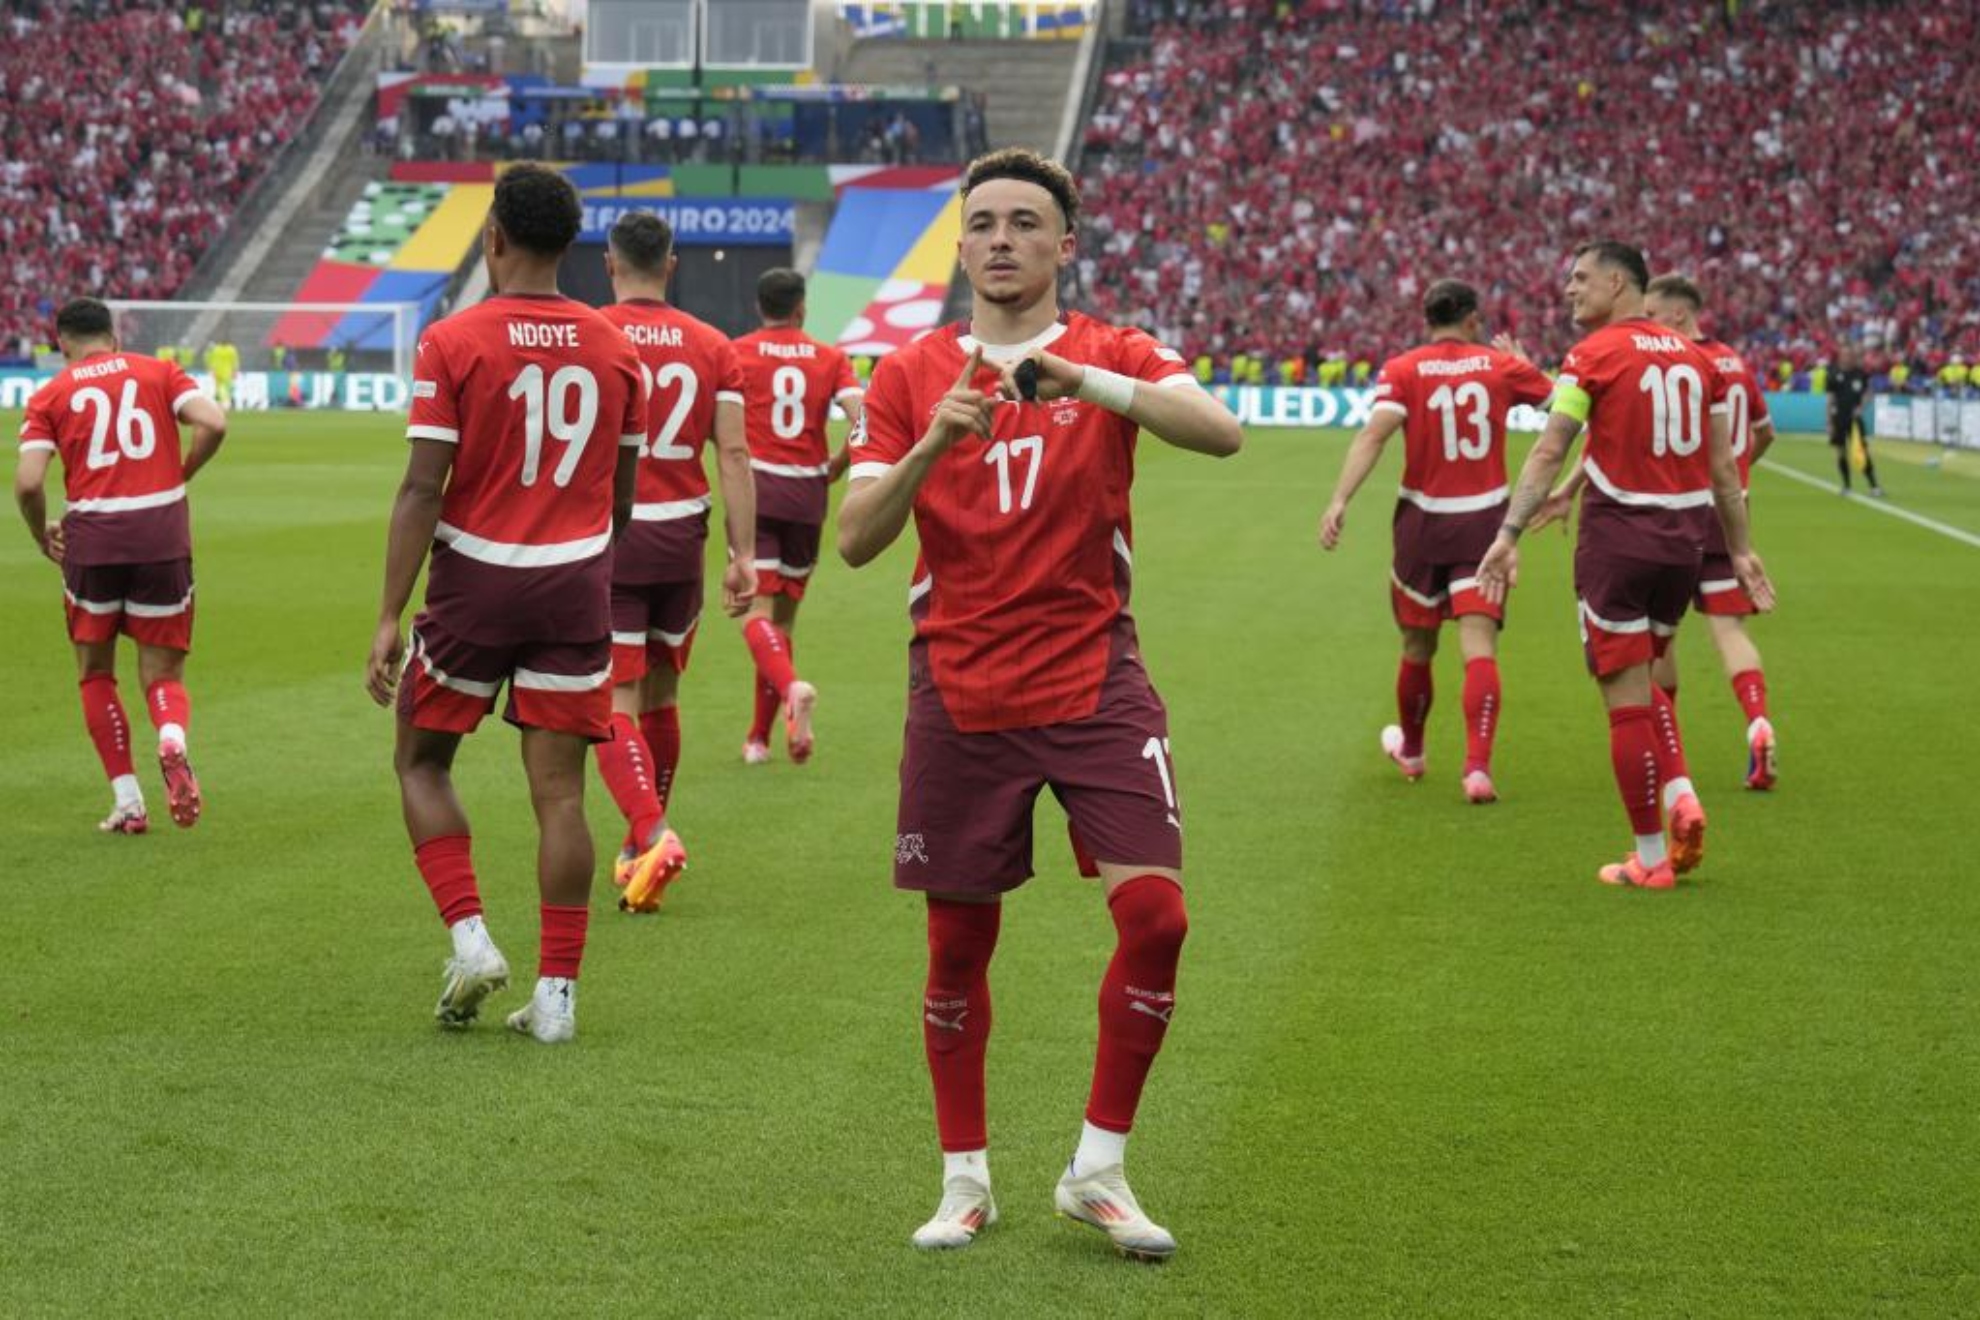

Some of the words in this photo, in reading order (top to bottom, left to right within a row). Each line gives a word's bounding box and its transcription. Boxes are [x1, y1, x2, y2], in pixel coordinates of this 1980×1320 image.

[72, 357, 129, 381] RIEDER
[507, 322, 580, 348] NDOYE
[69, 378, 157, 471] 26
[507, 363, 600, 488] 19
[771, 365, 807, 440] 8
[1425, 381, 1491, 462] 13
[1639, 363, 1703, 458] 10
[984, 434, 1044, 514] 17
[1141, 736, 1180, 811] 1
